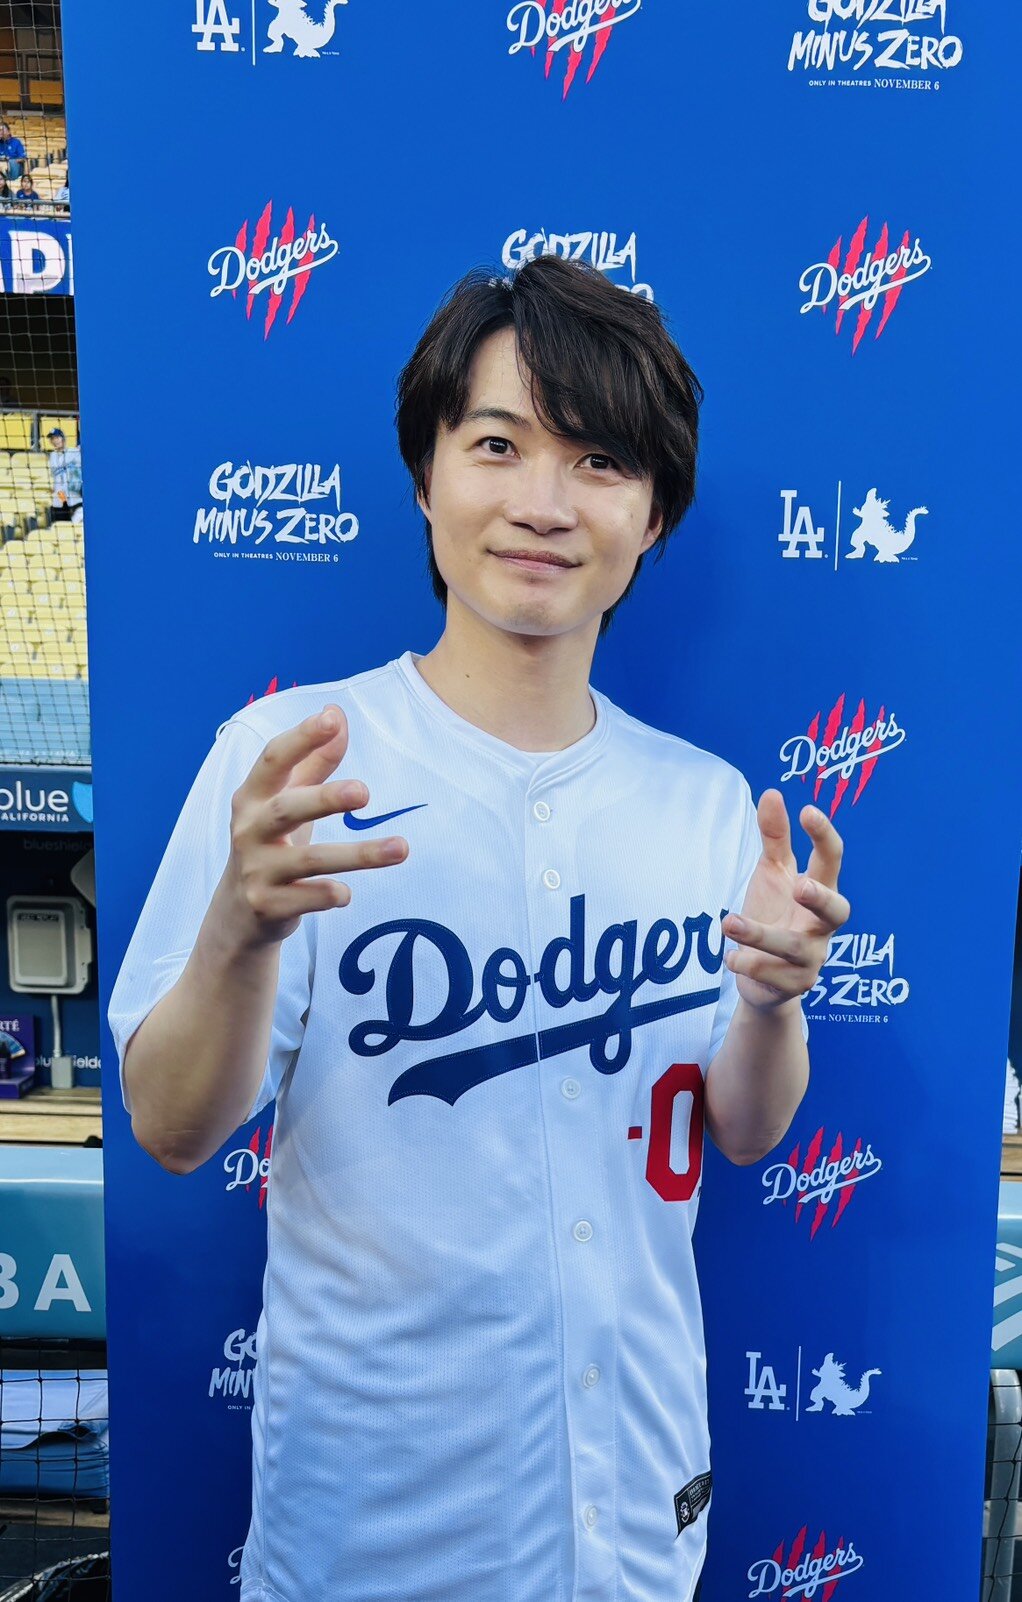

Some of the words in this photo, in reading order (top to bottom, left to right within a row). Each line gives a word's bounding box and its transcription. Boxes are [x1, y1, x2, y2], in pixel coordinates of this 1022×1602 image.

[787, 29, 873, 71] MINUS
[874, 29, 963, 70] ZERO
[808, 79, 826, 87] ONLY
[828, 79, 836, 87] IN
[874, 79, 932, 90] NOVEMBER
[933, 81, 940, 91] 6
[207, 223, 339, 297] Dodgers
[799, 238, 932, 314] Dodgers
[209, 460, 341, 512] GODZILLA
[193, 507, 273, 545] MINUS
[274, 507, 360, 545] ZERO
[778, 489, 825, 558] LA
[241, 552, 274, 560] THEATRES
[275, 551, 331, 563] NOVEMBER
[333, 553, 339, 563] 6
[779, 713, 907, 782] Dodgers
[0, 812, 69, 822] ALIFORNIA
[338, 893, 729, 1075] Dodger
[828, 973, 910, 1007] ZERO
[828, 1013, 881, 1023] NOVEMBER
[883, 1015, 889, 1023] 6
[762, 1144, 883, 1205] Dodgers
[744, 1351, 787, 1410] LA
[747, 1542, 864, 1598] Dodgers
